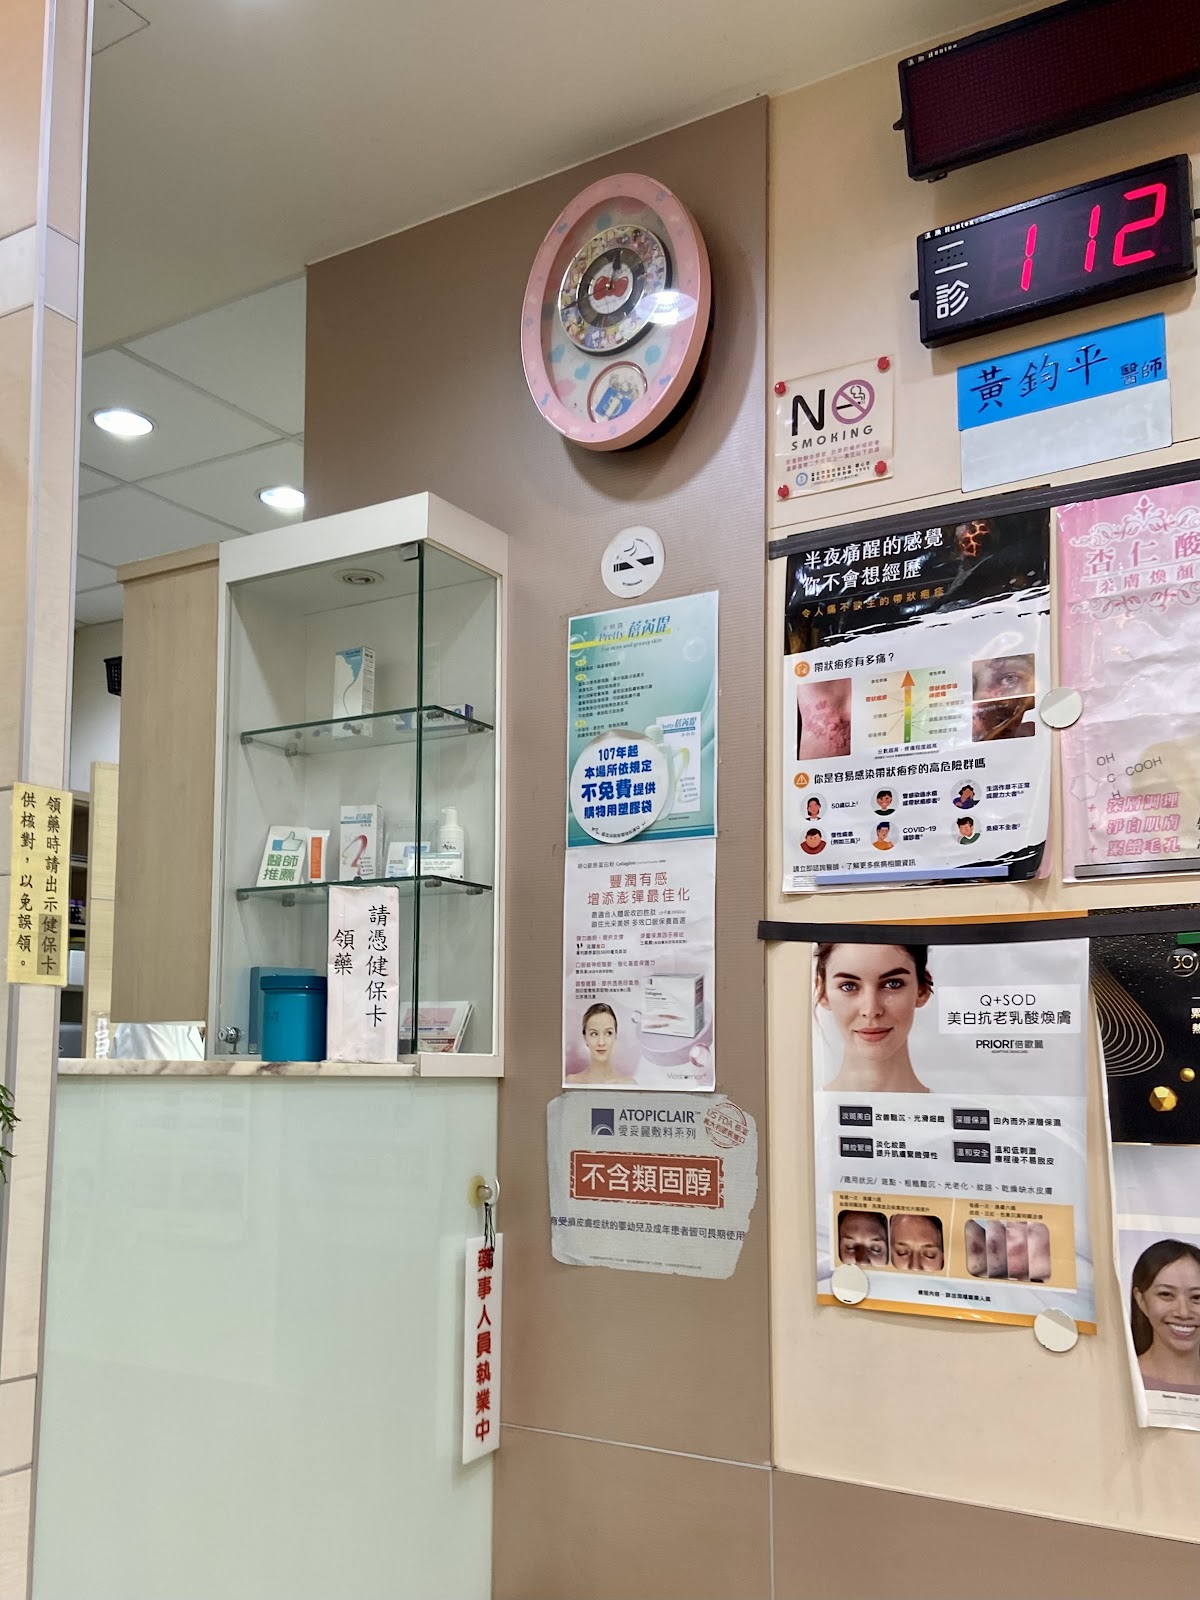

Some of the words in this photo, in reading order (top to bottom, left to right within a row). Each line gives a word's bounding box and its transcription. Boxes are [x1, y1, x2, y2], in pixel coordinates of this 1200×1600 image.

[1020, 183, 1167, 292] 112
[934, 240, 970, 319] 二診
[970, 343, 1109, 414] 黃鈞平
[1120, 356, 1163, 385] 醫師
[791, 425, 873, 451] SMOKING
[805, 527, 944, 570] 半夜痛醒的感覺
[1088, 531, 1200, 574] 杏仁酸
[803, 558, 922, 597] 你不會想經歷
[598, 744, 638, 761] 107年起
[1096, 753, 1115, 766] OH
[585, 760, 652, 779] 本場所依規定
[1125, 756, 1163, 776] COOH
[1107, 774, 1116, 783] C
[581, 779, 656, 802] 不免費提供
[584, 800, 652, 819] 購物用塑膠袋
[1107, 792, 1180, 813] 深層調理
[1107, 815, 1181, 835] 淨白肌膚
[266, 853, 299, 867] 醫師
[16, 791, 37, 967] 供核對，以免誤領。
[262, 868, 296, 882] 推薦
[610, 872, 668, 888] 豐潤有感
[41, 796, 62, 975] 領藥時請出示健保卡
[587, 887, 690, 906] 增添澎彈最佳化
[332, 929, 355, 976] 領藥
[1172, 955, 1194, 969] 30
[365, 904, 390, 1027] 請憑健保卡
[980, 994, 1036, 1007] Q+SOD
[947, 1010, 1072, 1025] 美白抗老乳酸煥膚
[618, 1124, 696, 1140] 愛妥麗敷料系列
[956, 1148, 989, 1158] 溫和安全
[581, 1162, 712, 1197] 不含類固醇
[475, 1247, 493, 1443] 藥事人員執業中
